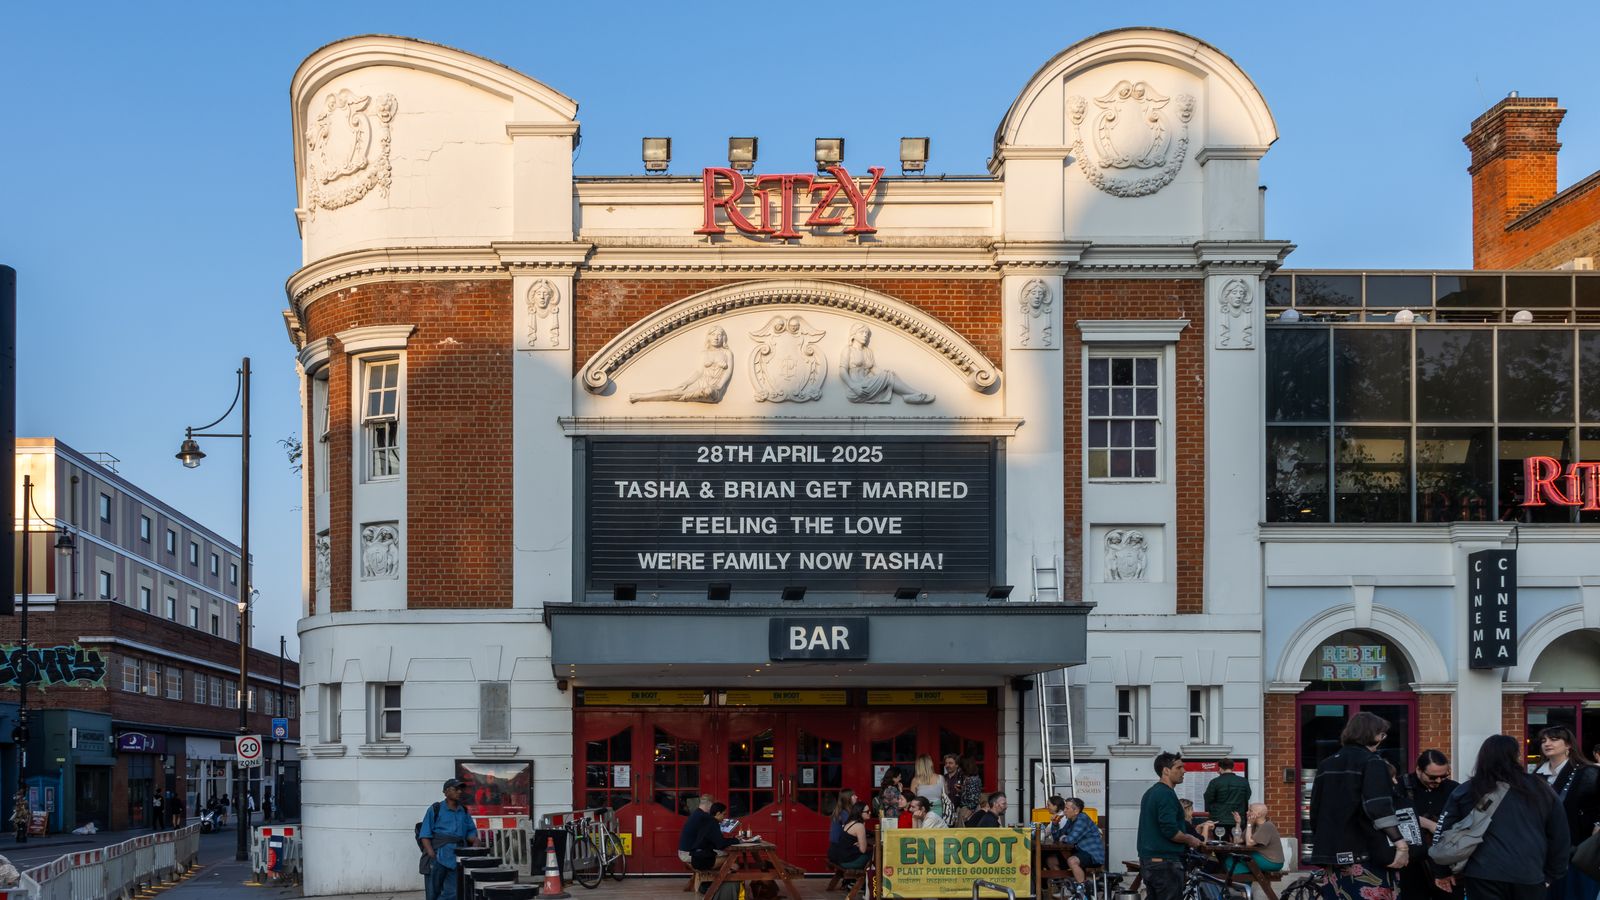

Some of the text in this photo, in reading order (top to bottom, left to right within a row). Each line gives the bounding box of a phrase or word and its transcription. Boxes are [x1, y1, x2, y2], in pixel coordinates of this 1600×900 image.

[697, 445, 884, 463] 28TH APRIL 2025
[615, 480, 969, 499] TASHA & BRIAN GET MARRIED
[681, 516, 902, 534] FEELING THE LOVE
[638, 552, 944, 570] WE'RE FAMILY NOW TASHA!
[1473, 560, 1484, 659] CINEMA
[1495, 557, 1510, 658] CINEMA
[789, 625, 850, 651] BAR
[1322, 645, 1386, 663] REBEL
[1322, 664, 1386, 681] REBEL
[242, 743, 258, 753] 20
[240, 759, 261, 767] ZONE
[1074, 778, 1101, 788] enguin
[899, 836, 1018, 865] EN ROOT
[897, 866, 1017, 876] PLANT POWERED GOODNESS
